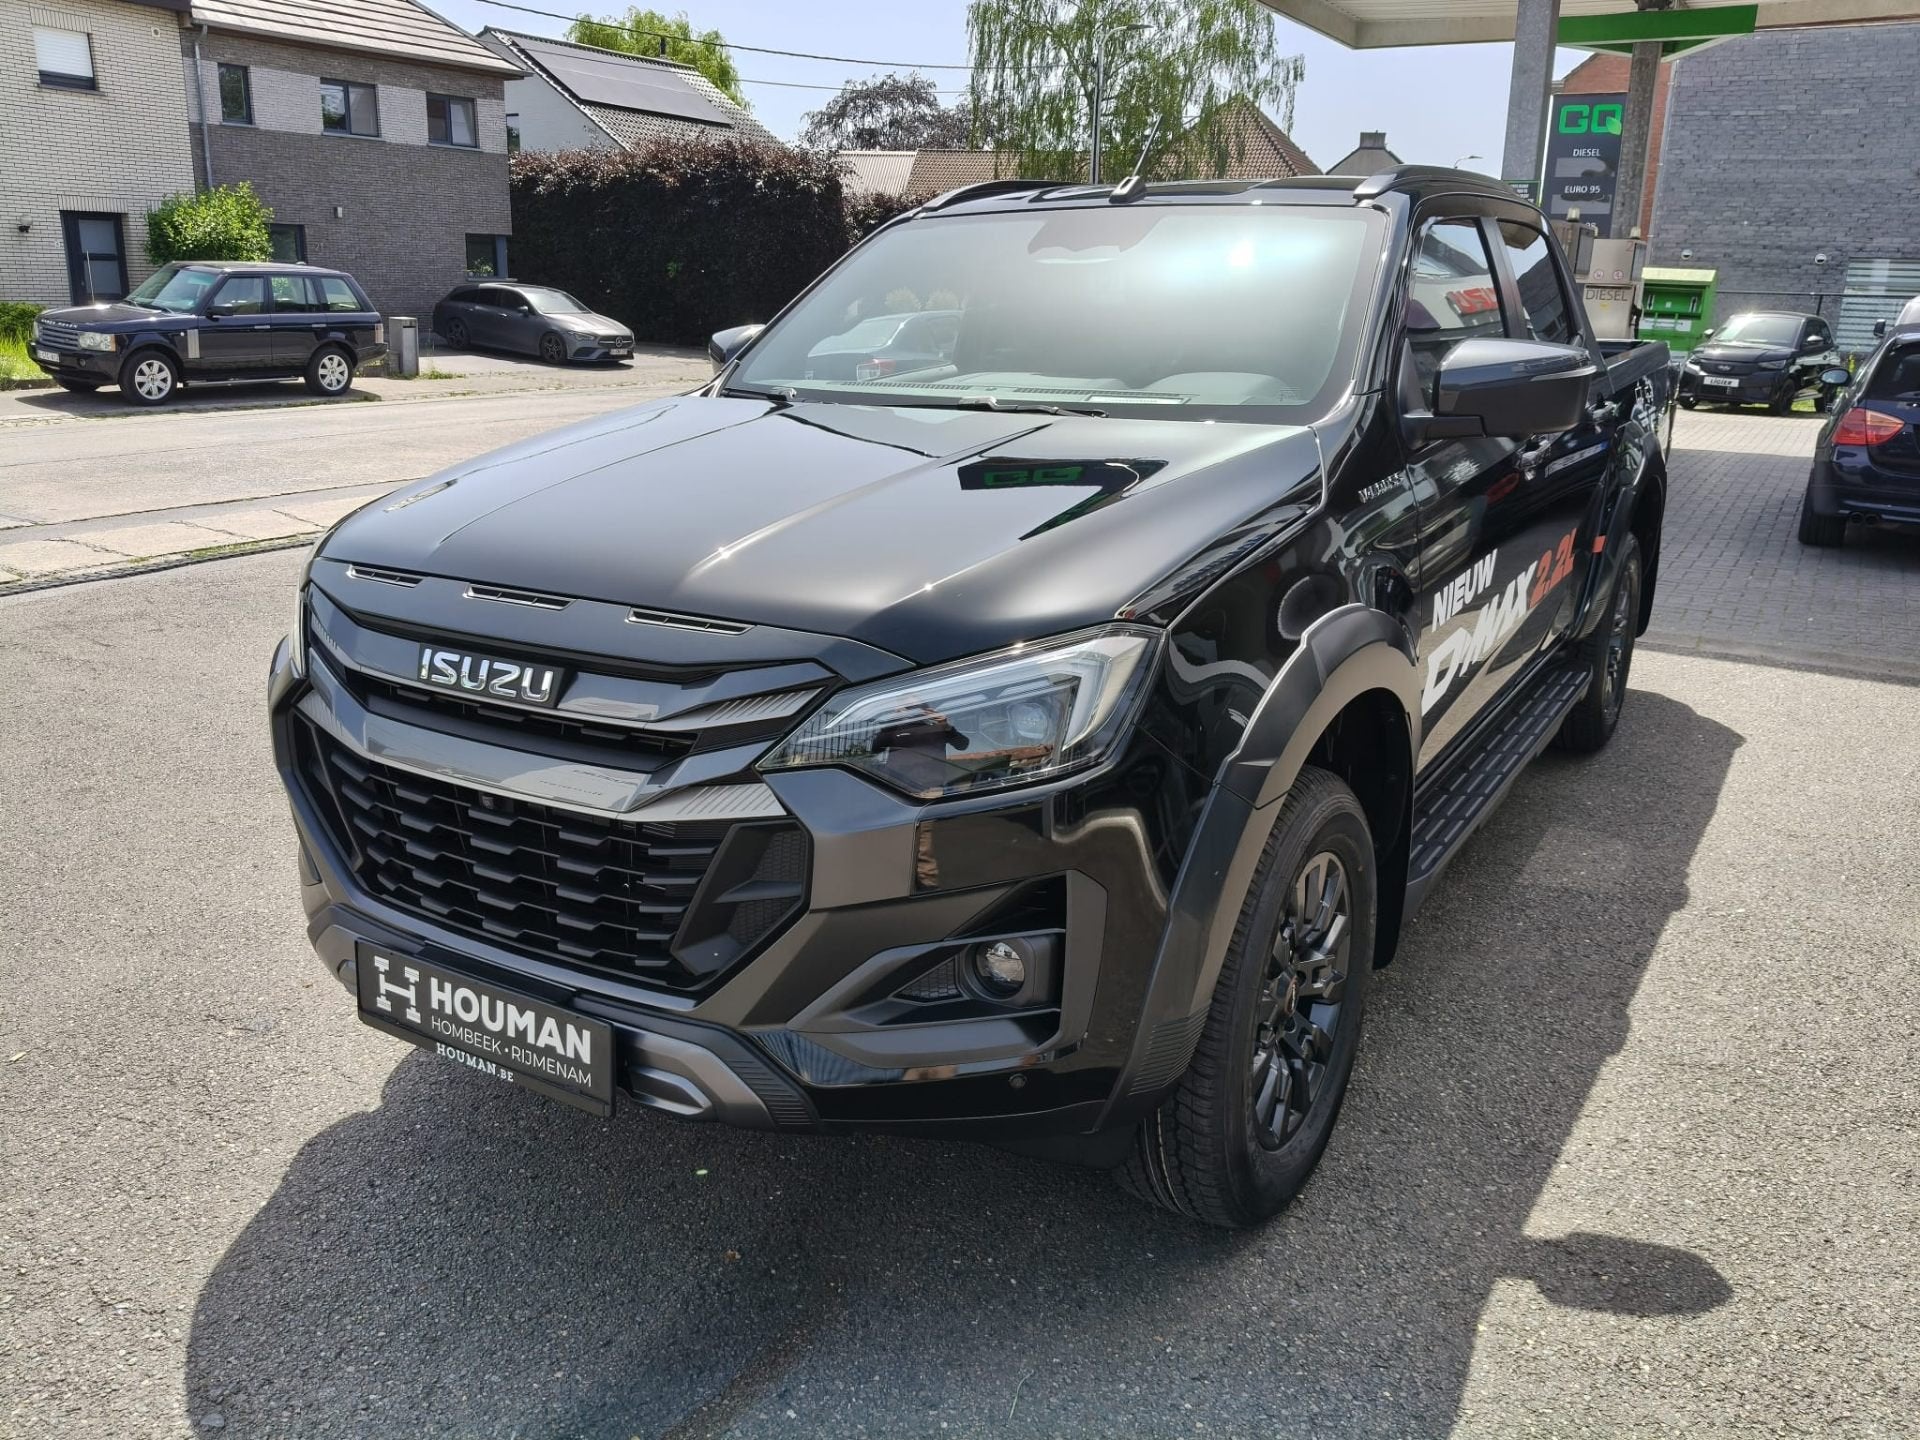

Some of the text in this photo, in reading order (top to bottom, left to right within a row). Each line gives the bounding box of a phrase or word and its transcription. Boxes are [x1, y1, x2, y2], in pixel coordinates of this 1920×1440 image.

[1572, 148, 1601, 157] DIESEL
[1564, 185, 1601, 194] EURO 95
[1585, 289, 1629, 301] DIESEL
[1431, 548, 1498, 634] NIEUW
[420, 648, 554, 703] ISUZU
[430, 976, 592, 1065] HOUMAN
[431, 1015, 592, 1088] HOMBEEK RIJMENAM
[435, 1042, 514, 1082] HOUMAN.BE
